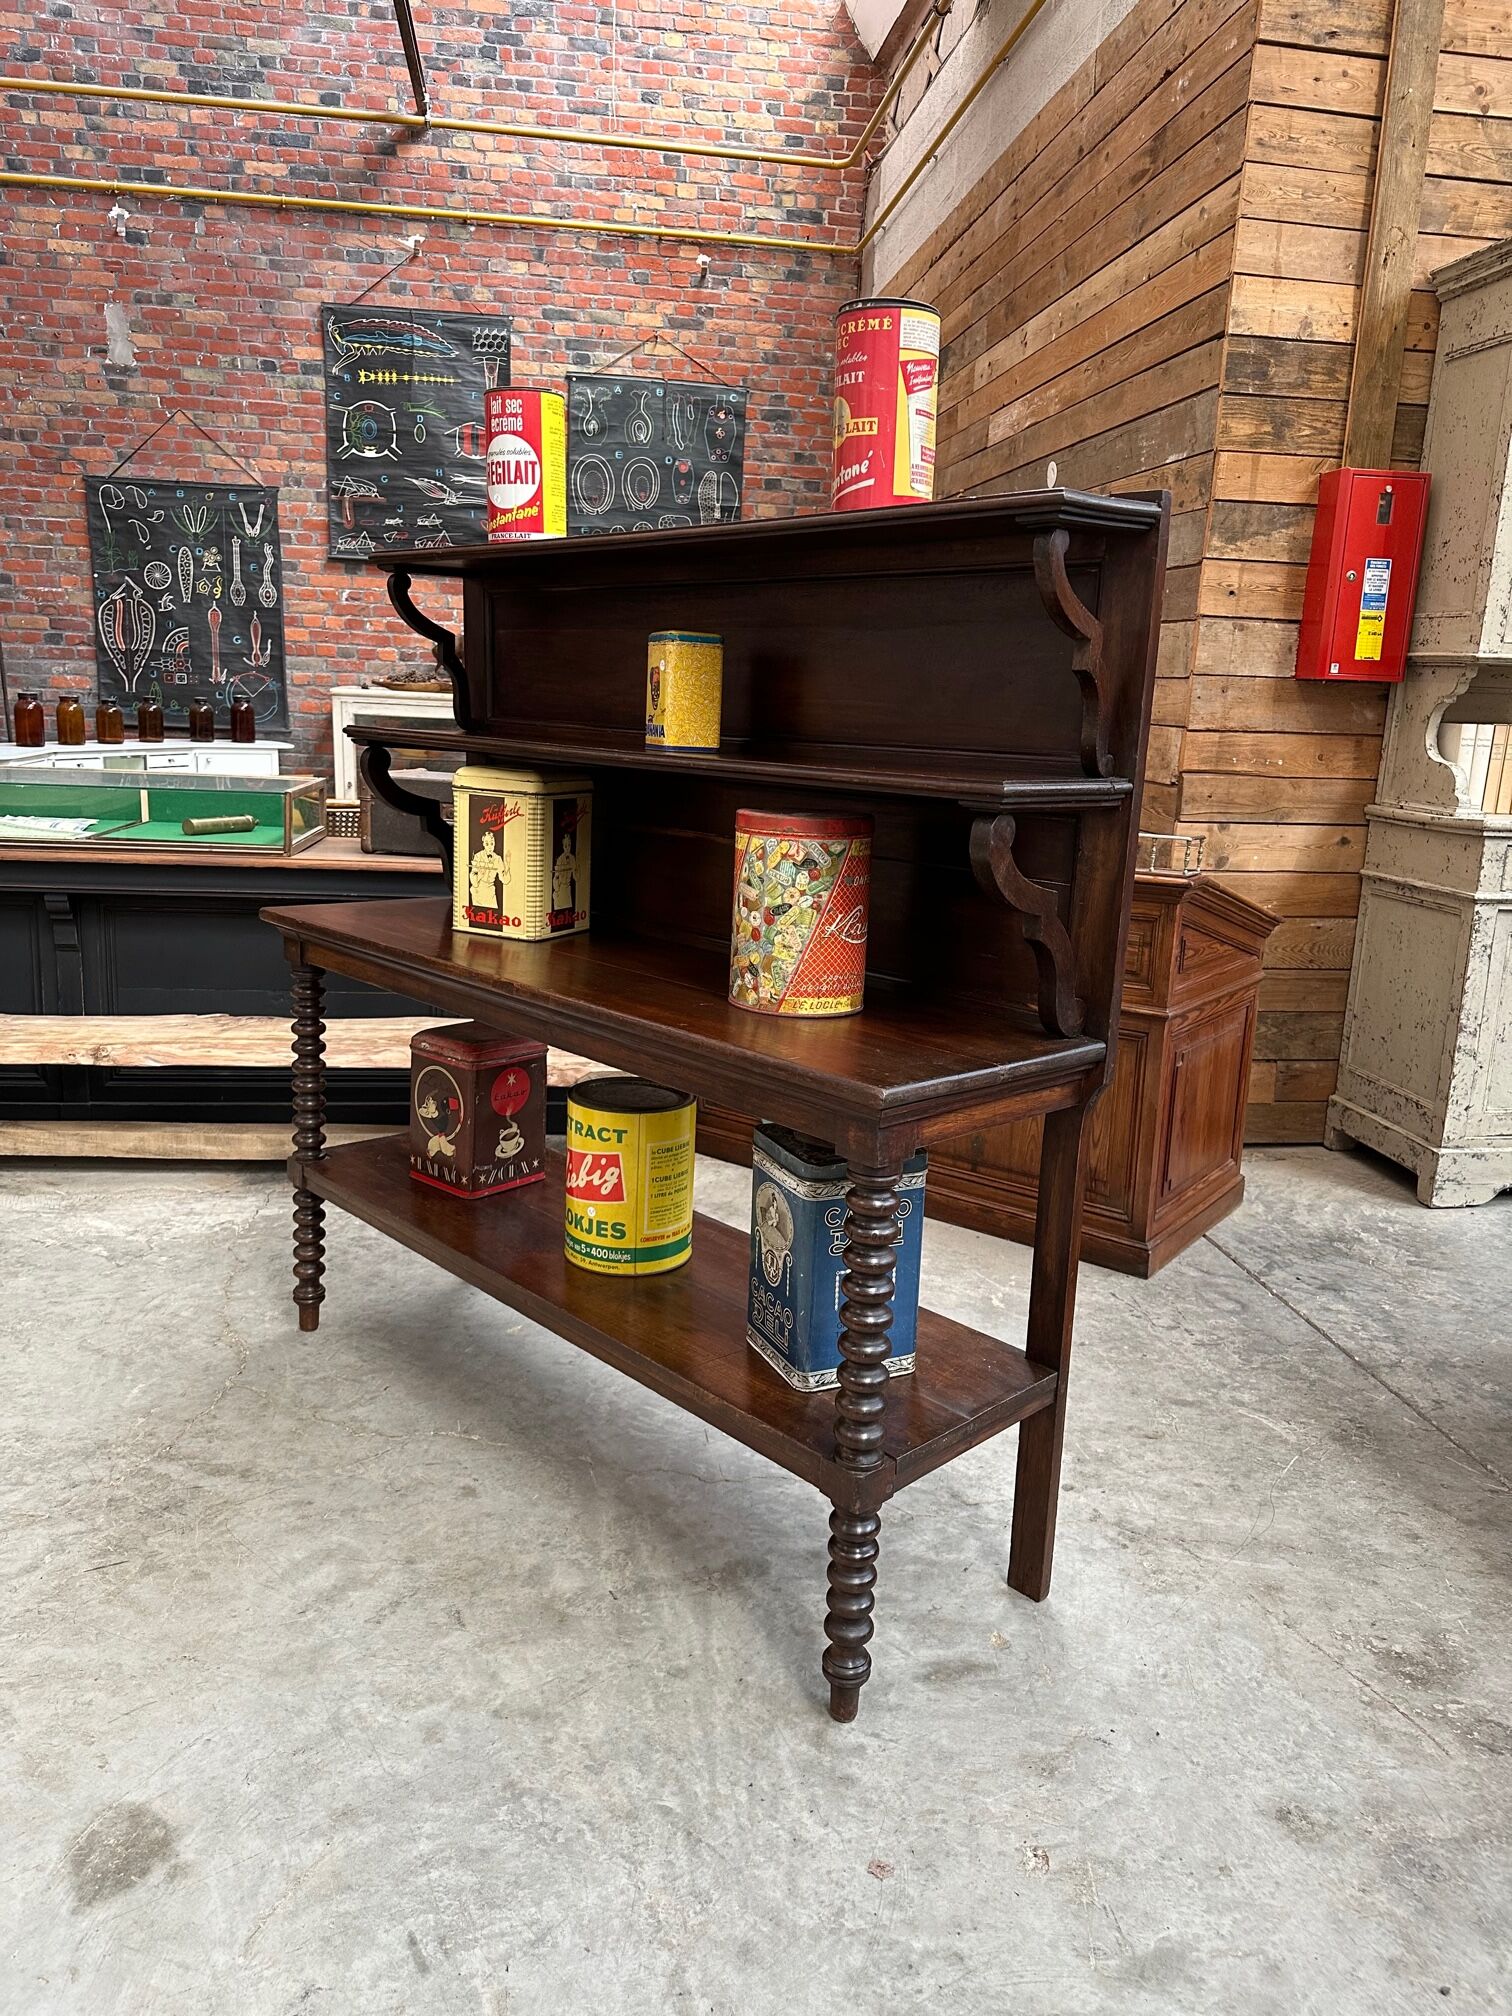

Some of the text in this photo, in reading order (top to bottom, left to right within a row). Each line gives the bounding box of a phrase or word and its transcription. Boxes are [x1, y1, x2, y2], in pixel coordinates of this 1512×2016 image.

[837, 316, 893, 336] CRÉMÉ
[343, 374, 351, 382] B
[614, 386, 622, 394] A
[656, 388, 664, 397] B
[333, 392, 341, 400] C
[729, 394, 737, 402] C
[490, 395, 523, 415] lait sec
[416, 415, 423, 423] D
[490, 414, 523, 433] écrémé
[615, 450, 623, 458] E
[665, 456, 672, 464] D
[435, 469, 443, 477] H
[380, 475, 388, 483] G
[229, 493, 237, 501] E
[396, 505, 403, 513] J
[169, 545, 177, 553] C
[196, 547, 203, 555] D
[250, 564, 257, 572] F
[98, 590, 105, 598] H
[233, 636, 241, 644] G
[462, 904, 522, 928] Kakao
[608, 1250, 631, 1263] blokjes
[751, 1277, 793, 1330] CACAO
